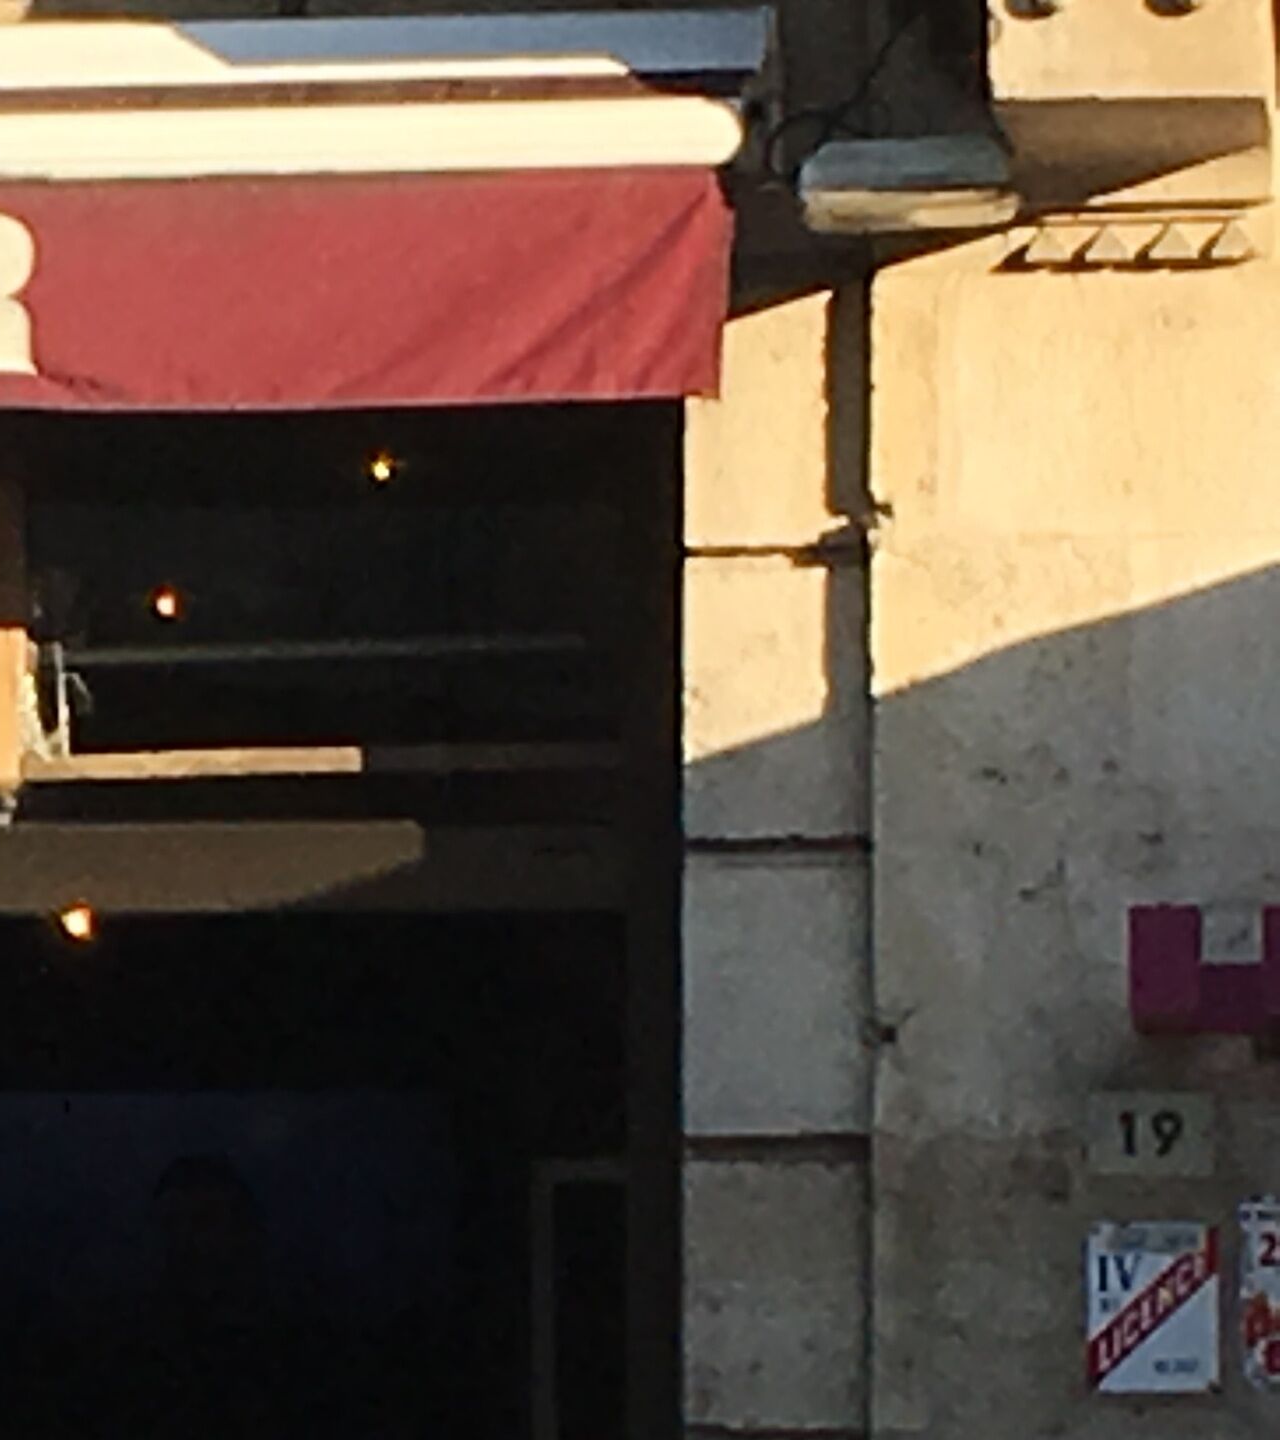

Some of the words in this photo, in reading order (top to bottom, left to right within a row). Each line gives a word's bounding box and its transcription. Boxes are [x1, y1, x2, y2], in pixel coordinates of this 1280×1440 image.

[1119, 1110, 1183, 1157] 19
[1098, 1254, 1141, 1292] IV
[1097, 1252, 1207, 1372] LICENCE
